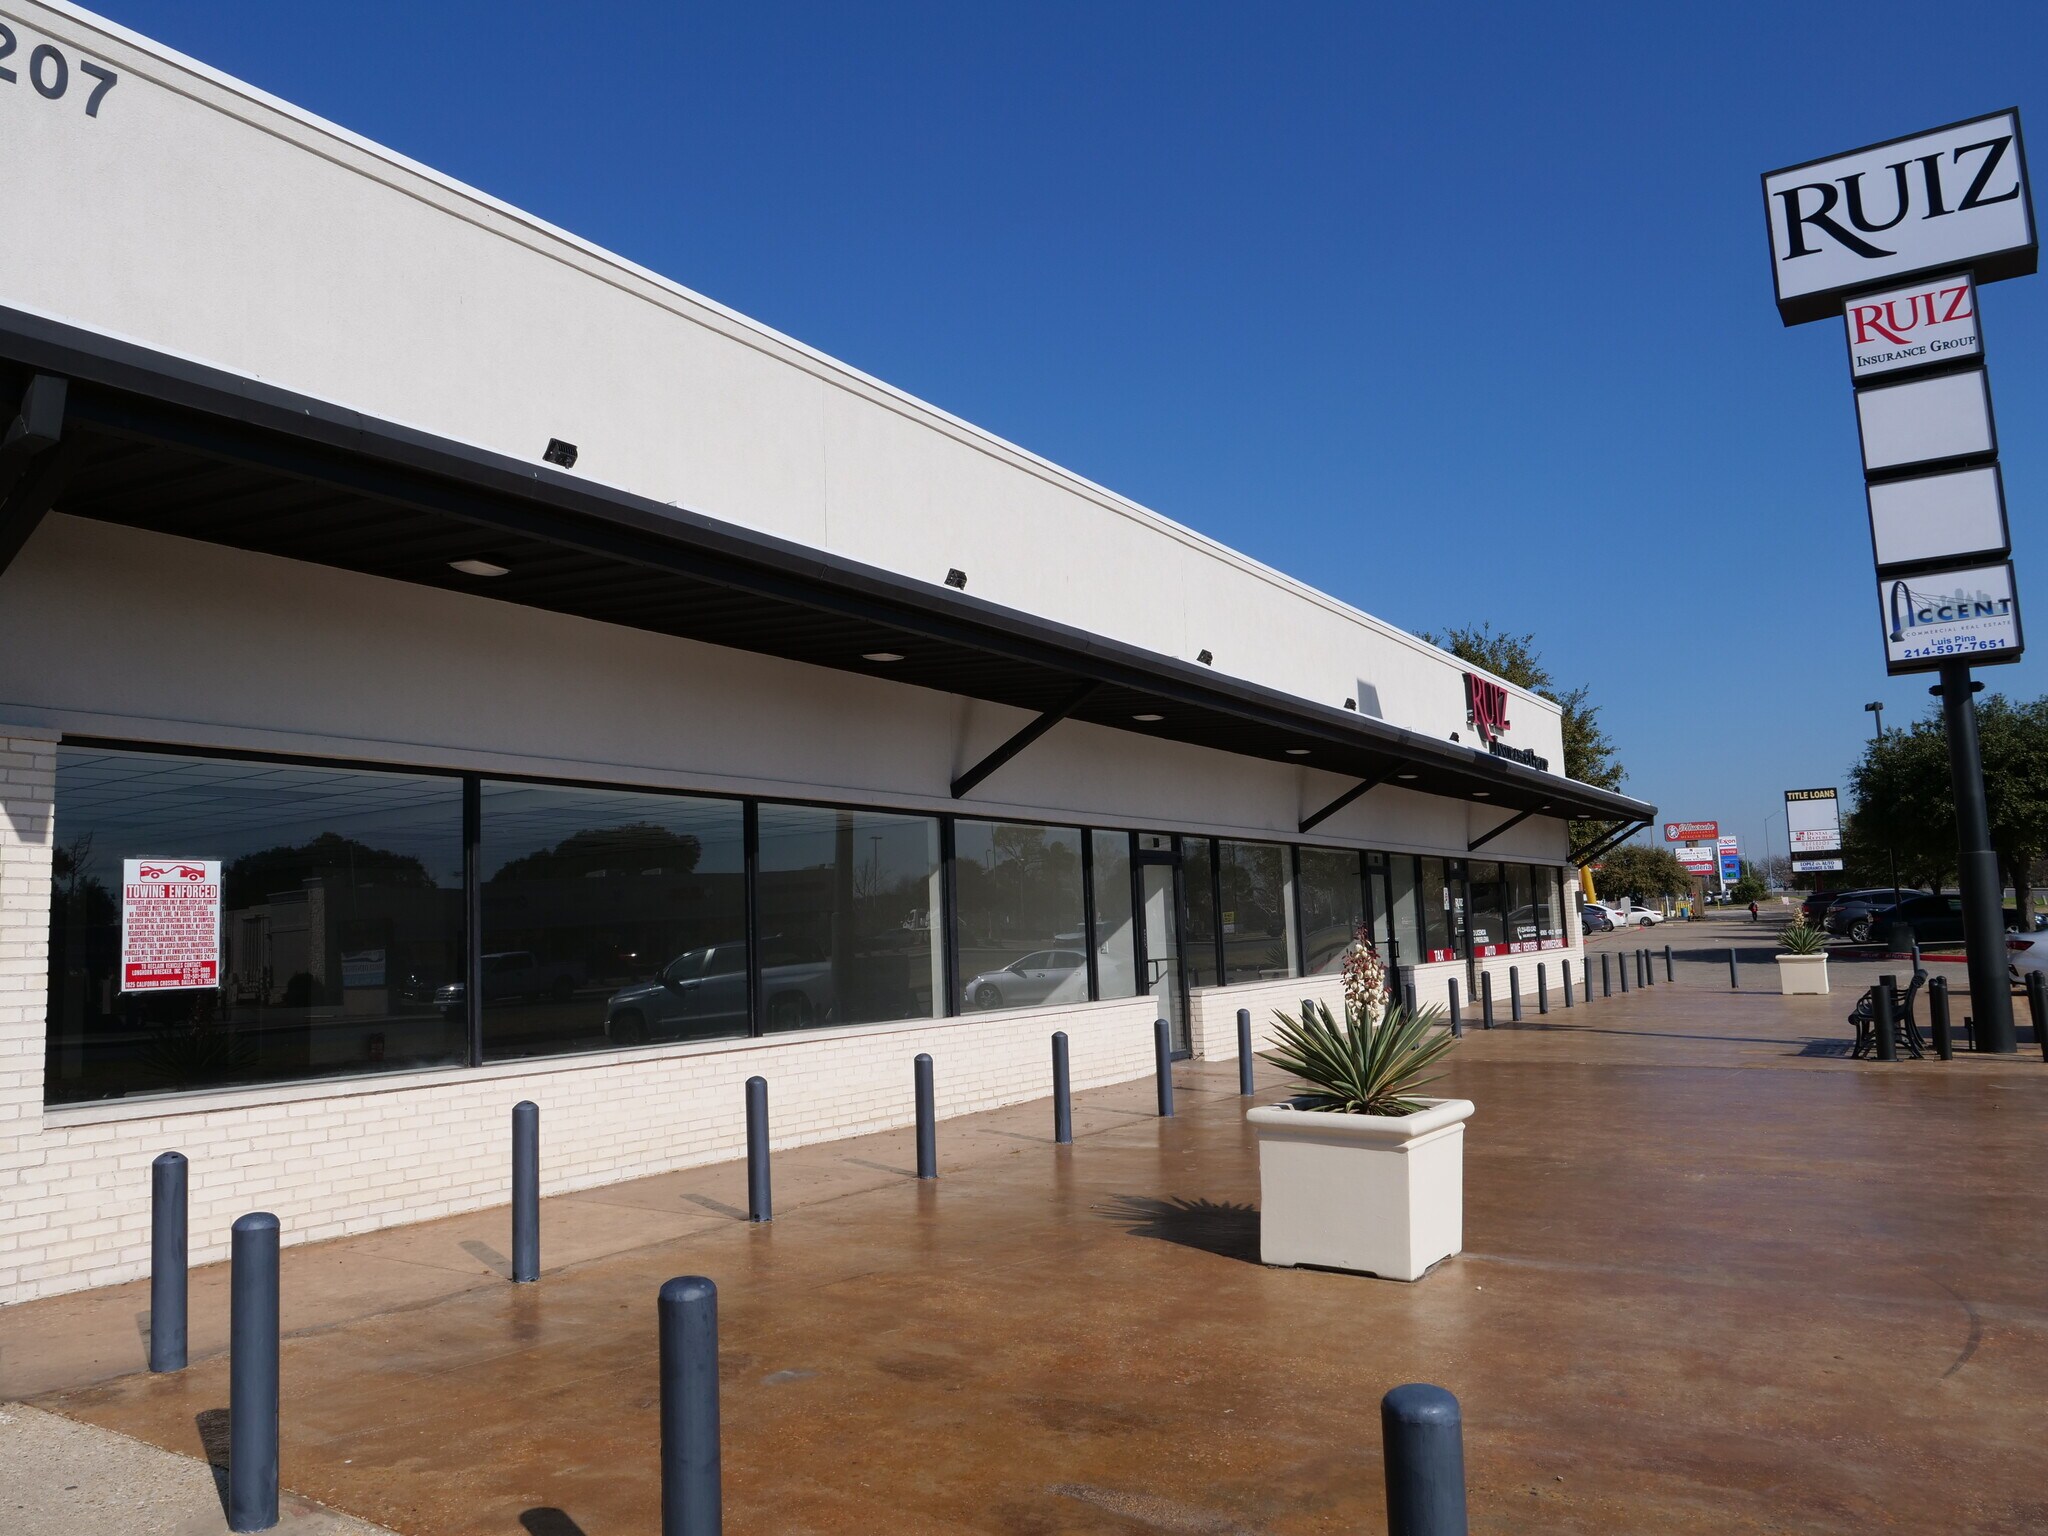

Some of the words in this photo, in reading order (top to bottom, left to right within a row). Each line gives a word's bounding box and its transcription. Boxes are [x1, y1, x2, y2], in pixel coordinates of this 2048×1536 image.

[1773, 135, 2020, 261] RUIZ
[1848, 285, 1973, 345] RUIZ
[1906, 627, 1957, 637] COMMERCIAL
[1983, 620, 2012, 628] ESTATE
[1931, 635, 1952, 646] Luis
[1954, 634, 1977, 644] Pina
[1904, 638, 2006, 658] 214-597-7651
[1464, 672, 1511, 742] RUIZ
[1787, 791, 1809, 800] TITLE
[1810, 789, 1835, 799] LOANS
[128, 885, 165, 898] TOWING
[169, 885, 216, 898] ENFORCED
[1484, 945, 1496, 956] AUTO
[1510, 943, 1520, 953] HOME
[1434, 950, 1444, 961] TAX
